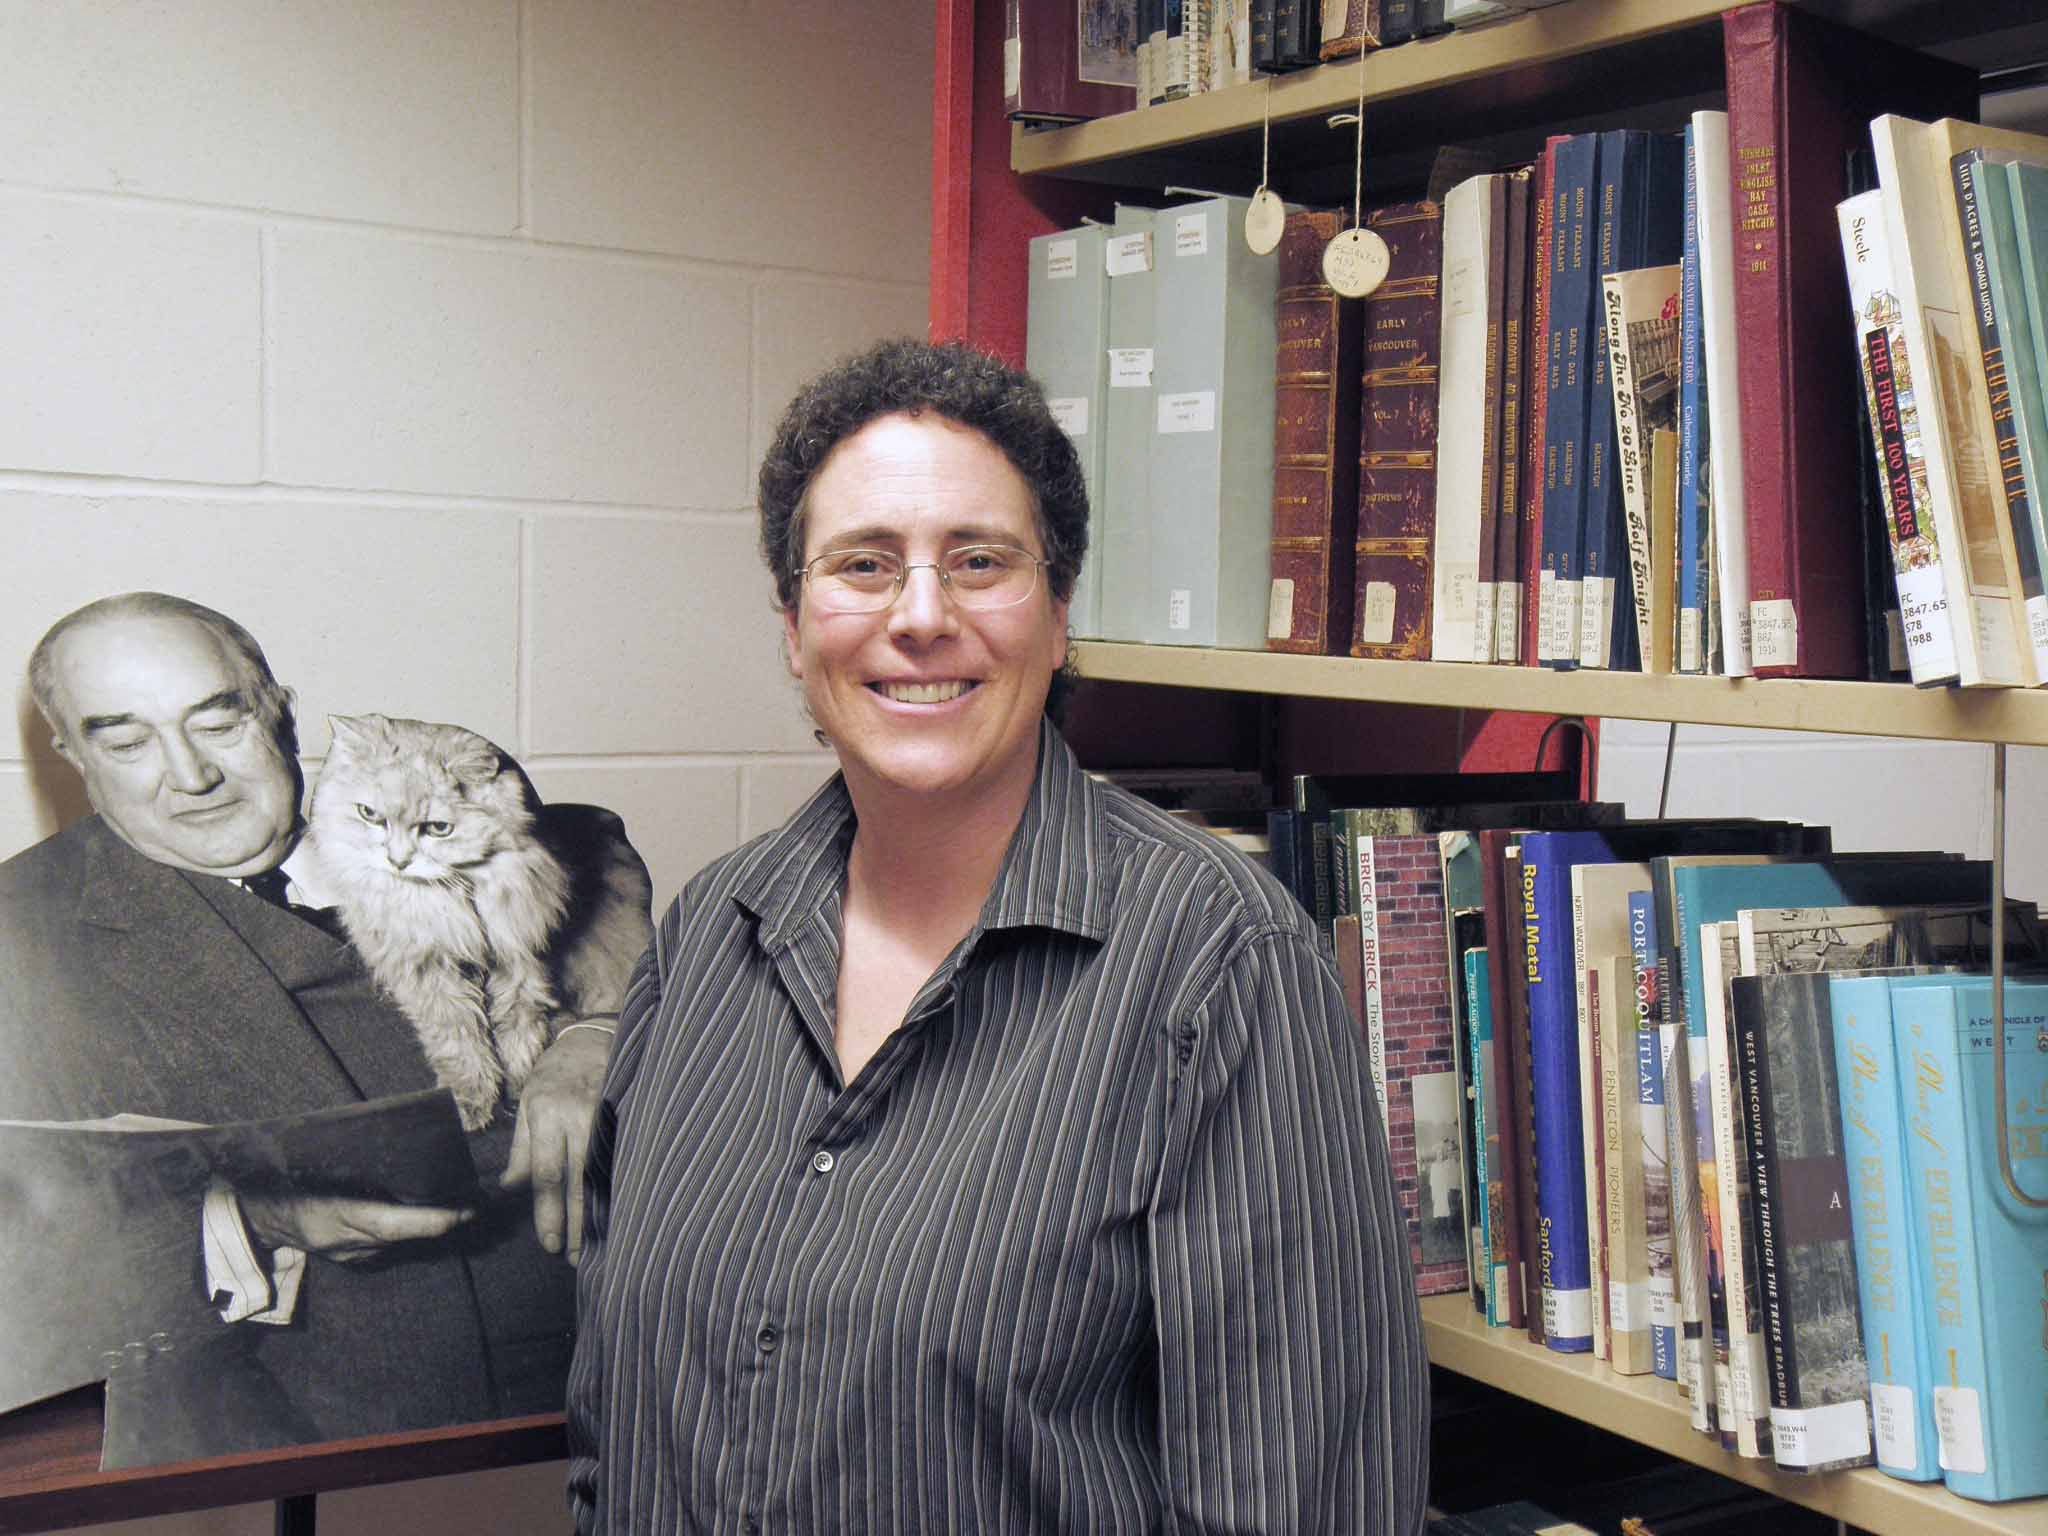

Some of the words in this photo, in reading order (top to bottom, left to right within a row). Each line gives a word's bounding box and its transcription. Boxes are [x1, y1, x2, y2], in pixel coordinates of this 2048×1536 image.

[1746, 162, 1770, 176] INLET
[1959, 163, 1970, 190] LILIA
[1575, 187, 1584, 219] MOUNT
[1687, 195, 1696, 213] THE
[1750, 191, 1766, 202] BAY
[1964, 193, 1980, 238] D'ACRES
[1686, 248, 1696, 266] THE
[1852, 216, 1870, 264] Steele
[1972, 241, 1981, 249] &
[1973, 253, 1988, 290] DONALD
[1376, 319, 1407, 330] EARLY
[1606, 290, 1621, 346] Along
[1980, 290, 1994, 327] LUXTON
[1368, 339, 1418, 352] VANCOUVER
[1871, 332, 1890, 375] THE
[1612, 353, 1627, 386] The
[1684, 355, 1697, 385] STORY
[1878, 379, 1899, 432] FIRST
[1621, 425, 1632, 447] 20
[1624, 447, 1638, 494] Line
[1887, 442, 1903, 470] 100
[1893, 475, 1915, 536] YEARS
[1628, 510, 1644, 558] Rolf
[1633, 560, 1650, 626] Knight
[1901, 593, 1912, 604] FC
[1903, 600, 1947, 619] 3847.65
[1905, 620, 1922, 633] S78
[1908, 632, 1933, 648] 1988
[1359, 852, 1372, 905] BRICK
[1523, 864, 1539, 920] Royal
[1363, 911, 1375, 933] BY
[1575, 896, 1583, 921] NORTH
[1576, 923, 1585, 971] VANCOUVER
[1633, 907, 1648, 963] PORT
[1364, 939, 1377, 990] BRICK
[1526, 925, 1543, 983] Metal
[1369, 1001, 1379, 1028] The
[1969, 1018, 1977, 1026] A
[1978, 1016, 2032, 1026] CHNICLE
[2033, 1016, 2047, 1025] OF
[1370, 1032, 1382, 1065] Story
[1635, 971, 1654, 1104] COQUITLAM
[1744, 1031, 1756, 1064] WEST
[1970, 1036, 2014, 1048] WET
[1373, 1071, 1385, 1088] of
[1605, 1070, 1618, 1151] PENTICTON
[1749, 1069, 1763, 1146] VANCOUVER
[1756, 1151, 1765, 1160] A
[1756, 1165, 1769, 1199] VIEW
[1609, 1167, 1621, 1235] PIONEERS
[1829, 1191, 1842, 1209] A
[1760, 1201, 1776, 1272] THROUGH
[1860, 1155, 1897, 1313] EXCELLENCE
[1925, 1167, 1964, 1329] EXCELLENCE
[1539, 1217, 1555, 1288] Sanford
[1767, 1272, 1778, 1299] THE
[1770, 1303, 1782, 1347] TREES
[1655, 1326, 1666, 1371] DAVIS
[1773, 1347, 1788, 1408] BRADBUR
